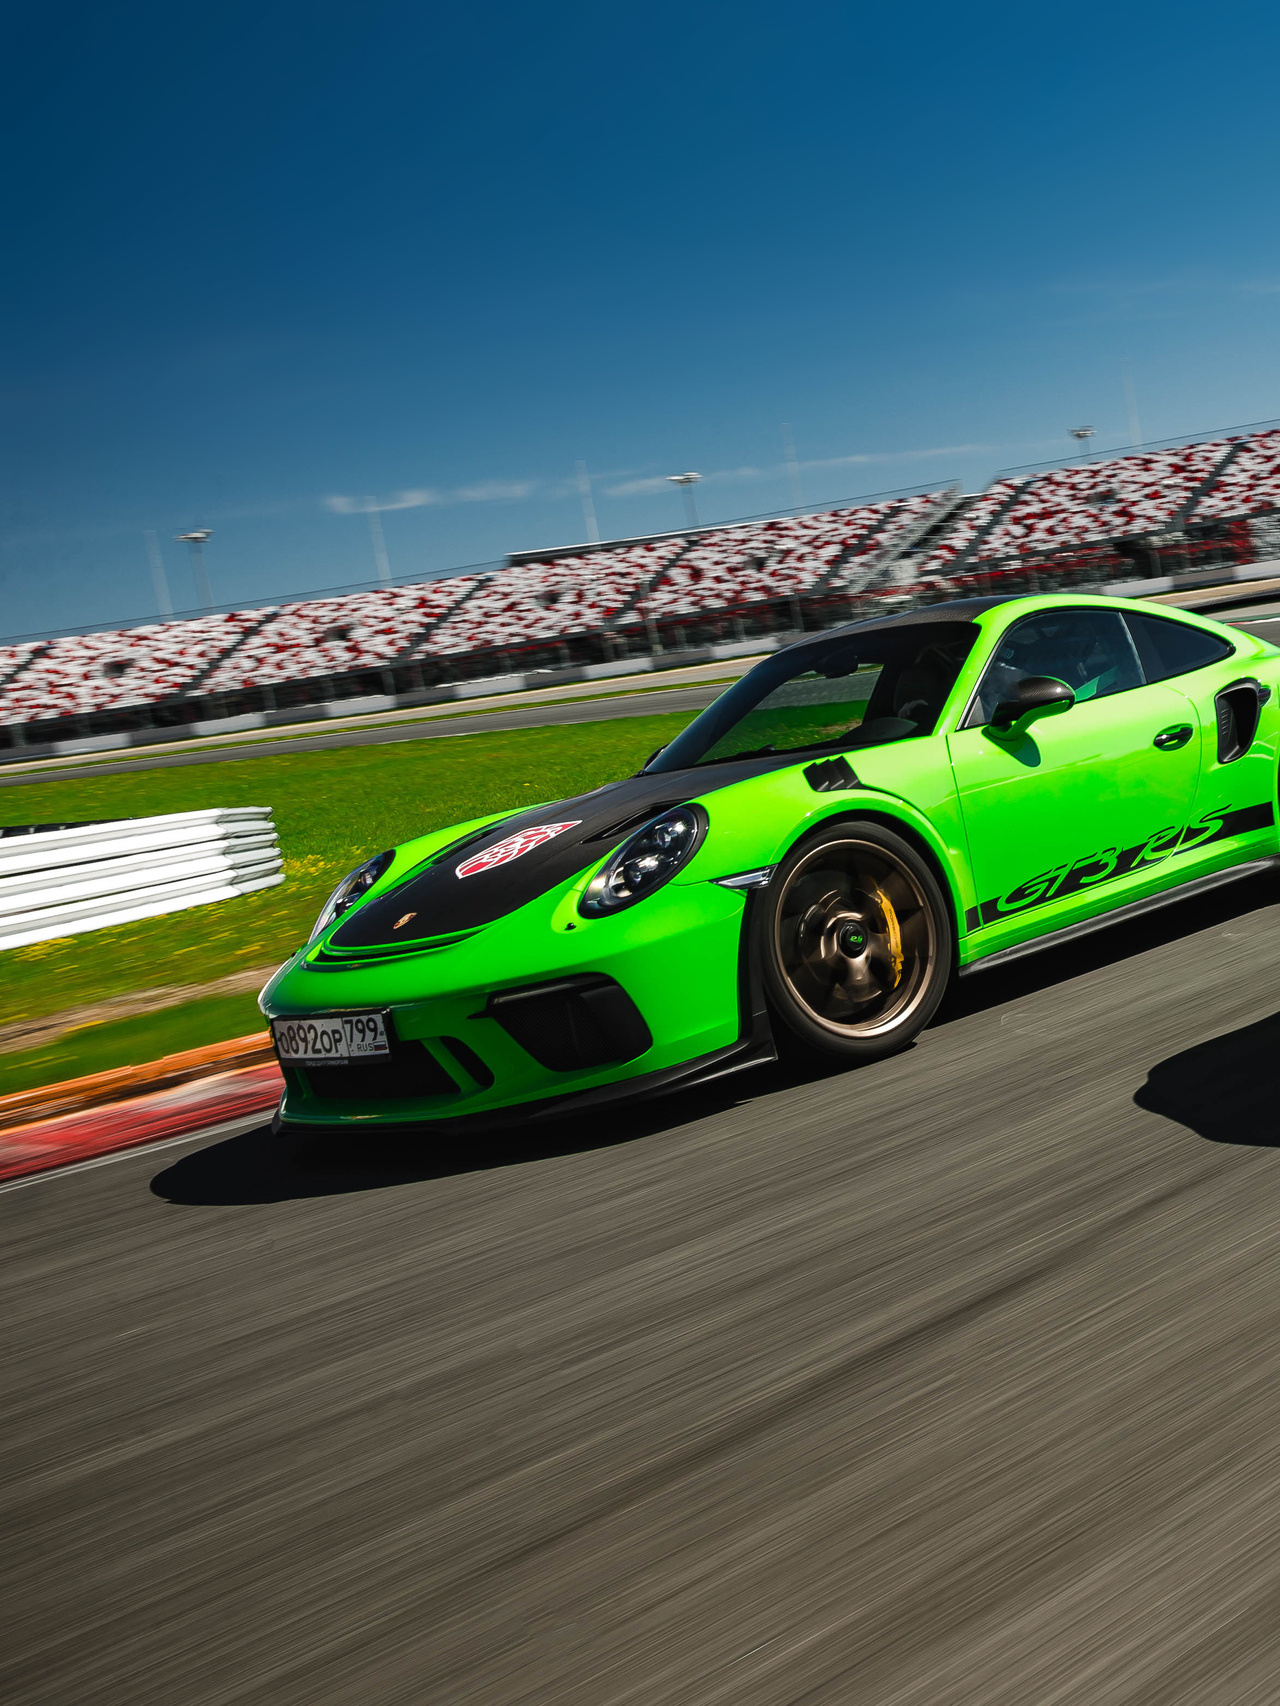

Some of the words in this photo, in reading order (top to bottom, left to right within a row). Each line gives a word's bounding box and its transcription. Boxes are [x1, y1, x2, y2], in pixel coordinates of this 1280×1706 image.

[996, 844, 1121, 911] GT3
[1130, 803, 1233, 868] RS
[344, 1017, 378, 1044] 799
[357, 1042, 374, 1051] RUS
